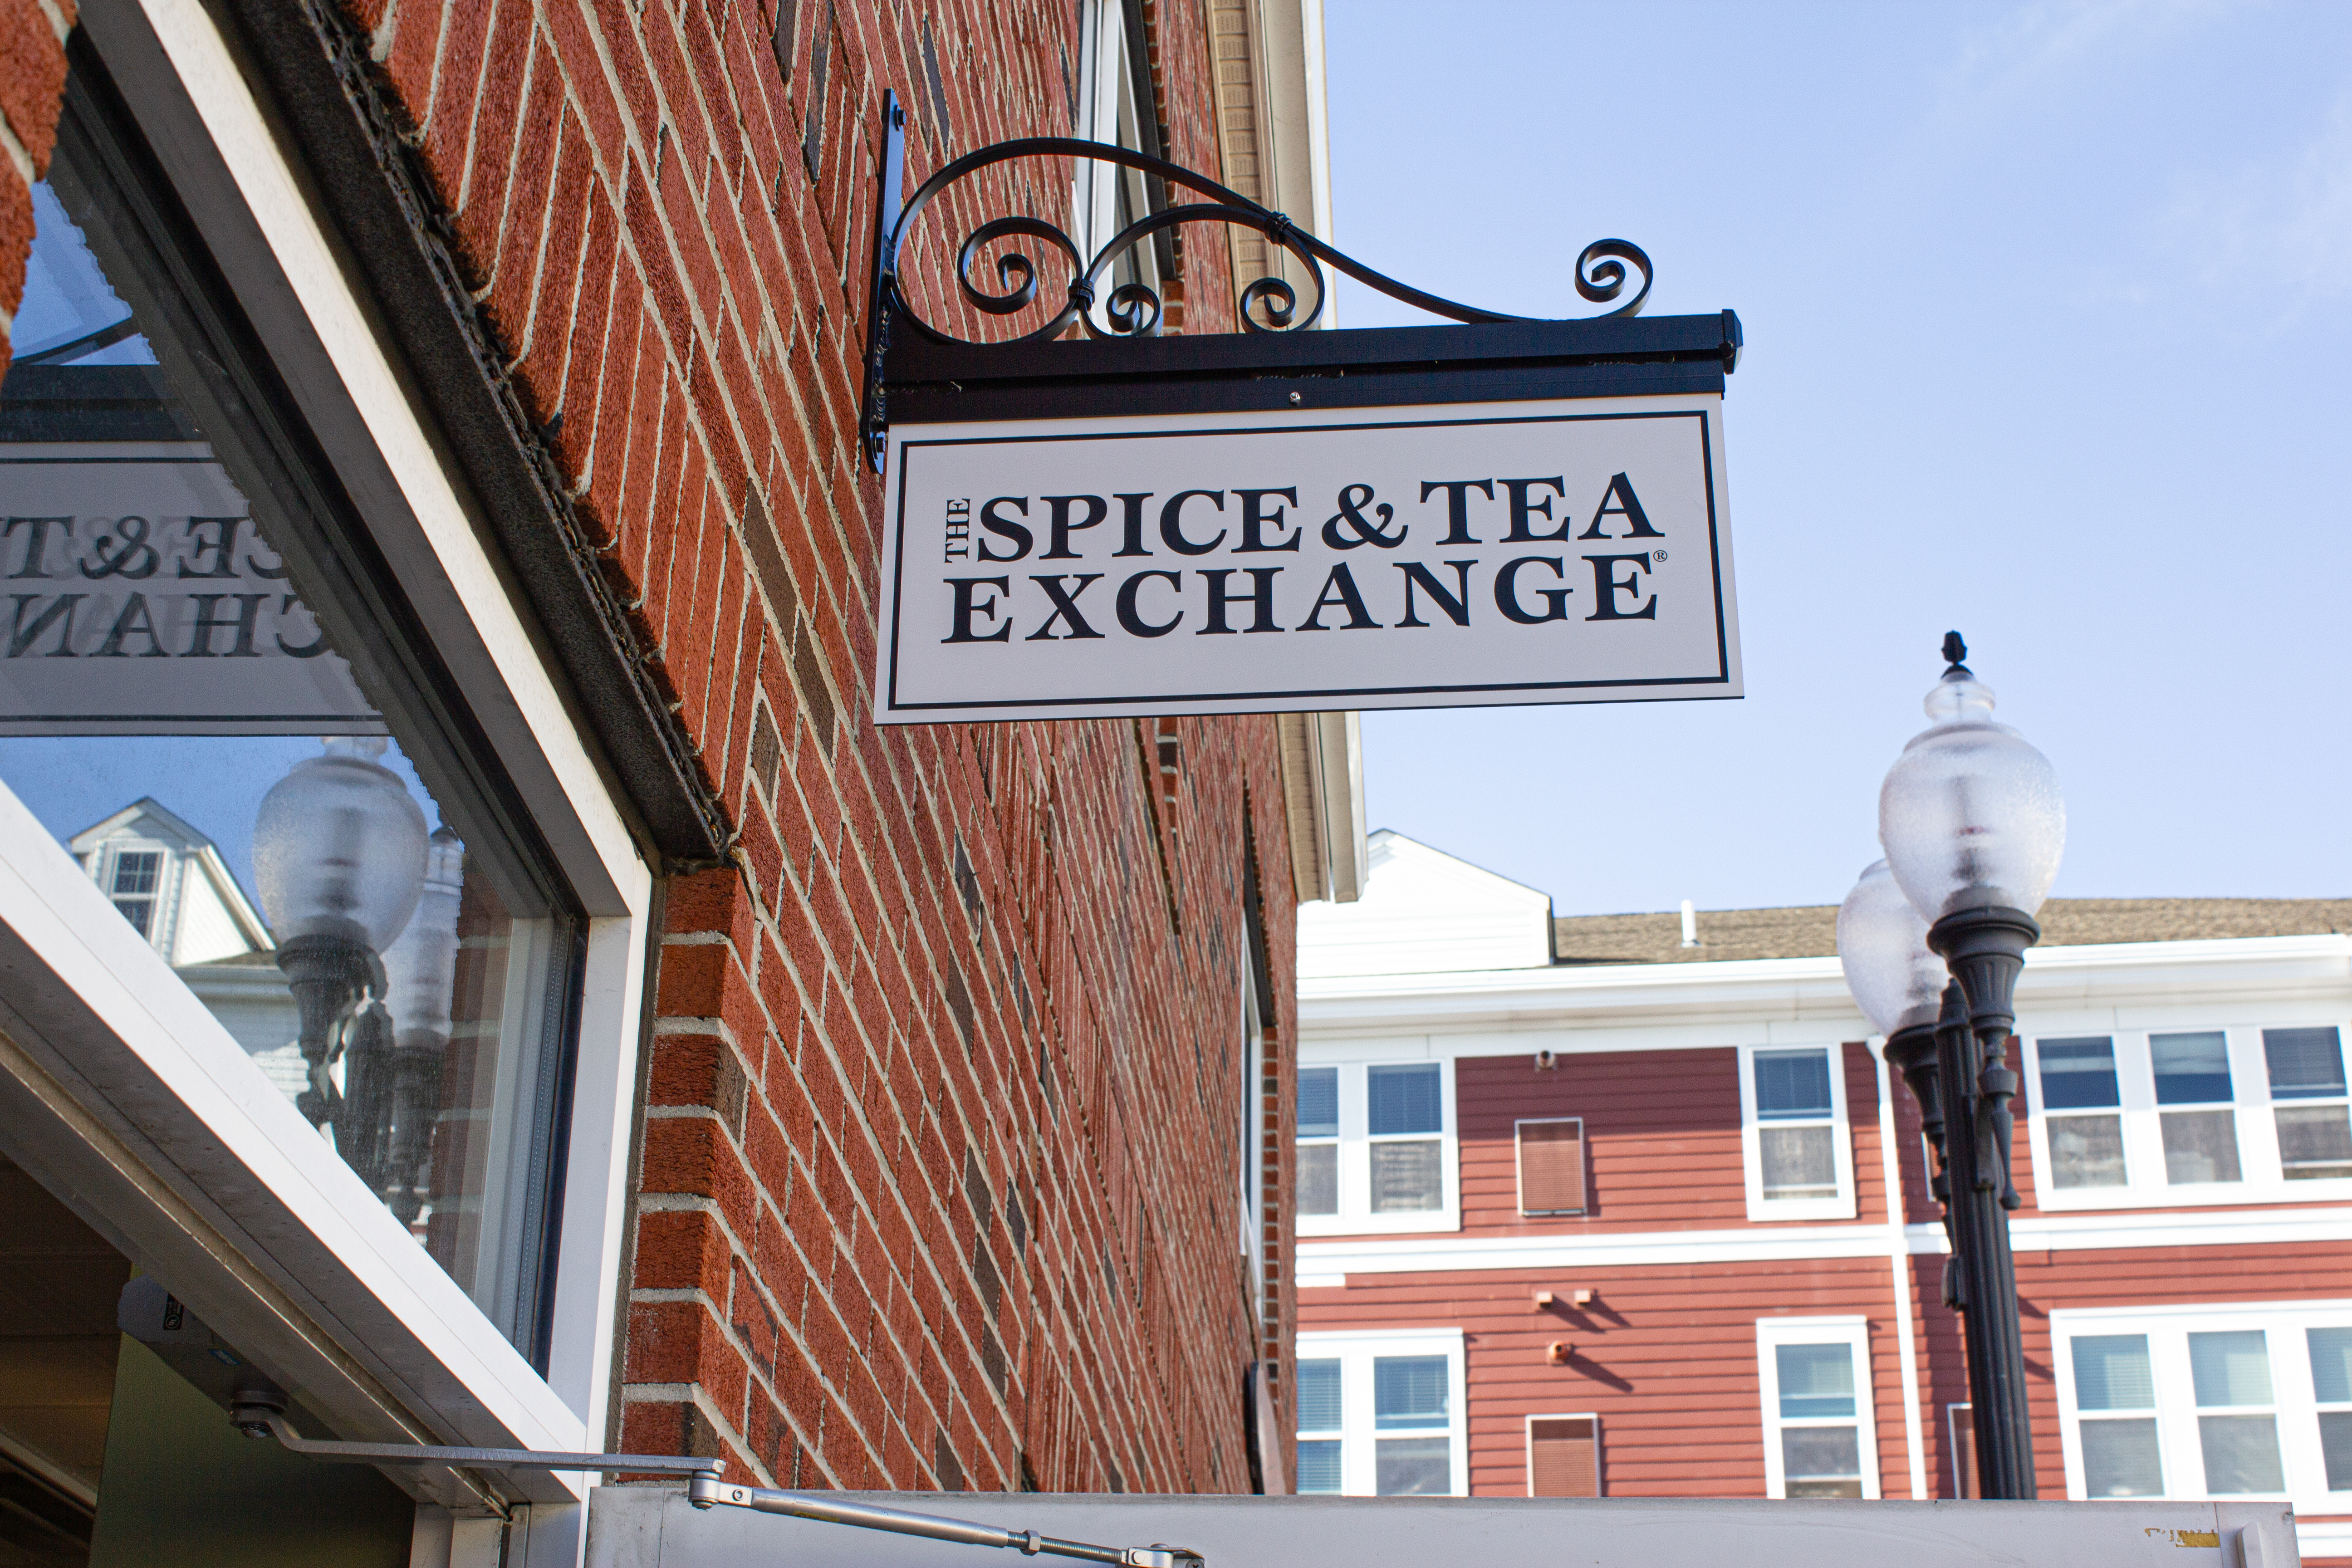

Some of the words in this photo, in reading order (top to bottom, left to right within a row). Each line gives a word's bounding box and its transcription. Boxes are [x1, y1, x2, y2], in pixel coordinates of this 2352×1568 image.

[944, 498, 970, 564] THE
[977, 485, 1302, 563] SPICE
[1321, 484, 1409, 550] &
[1420, 471, 1665, 545] TEA
